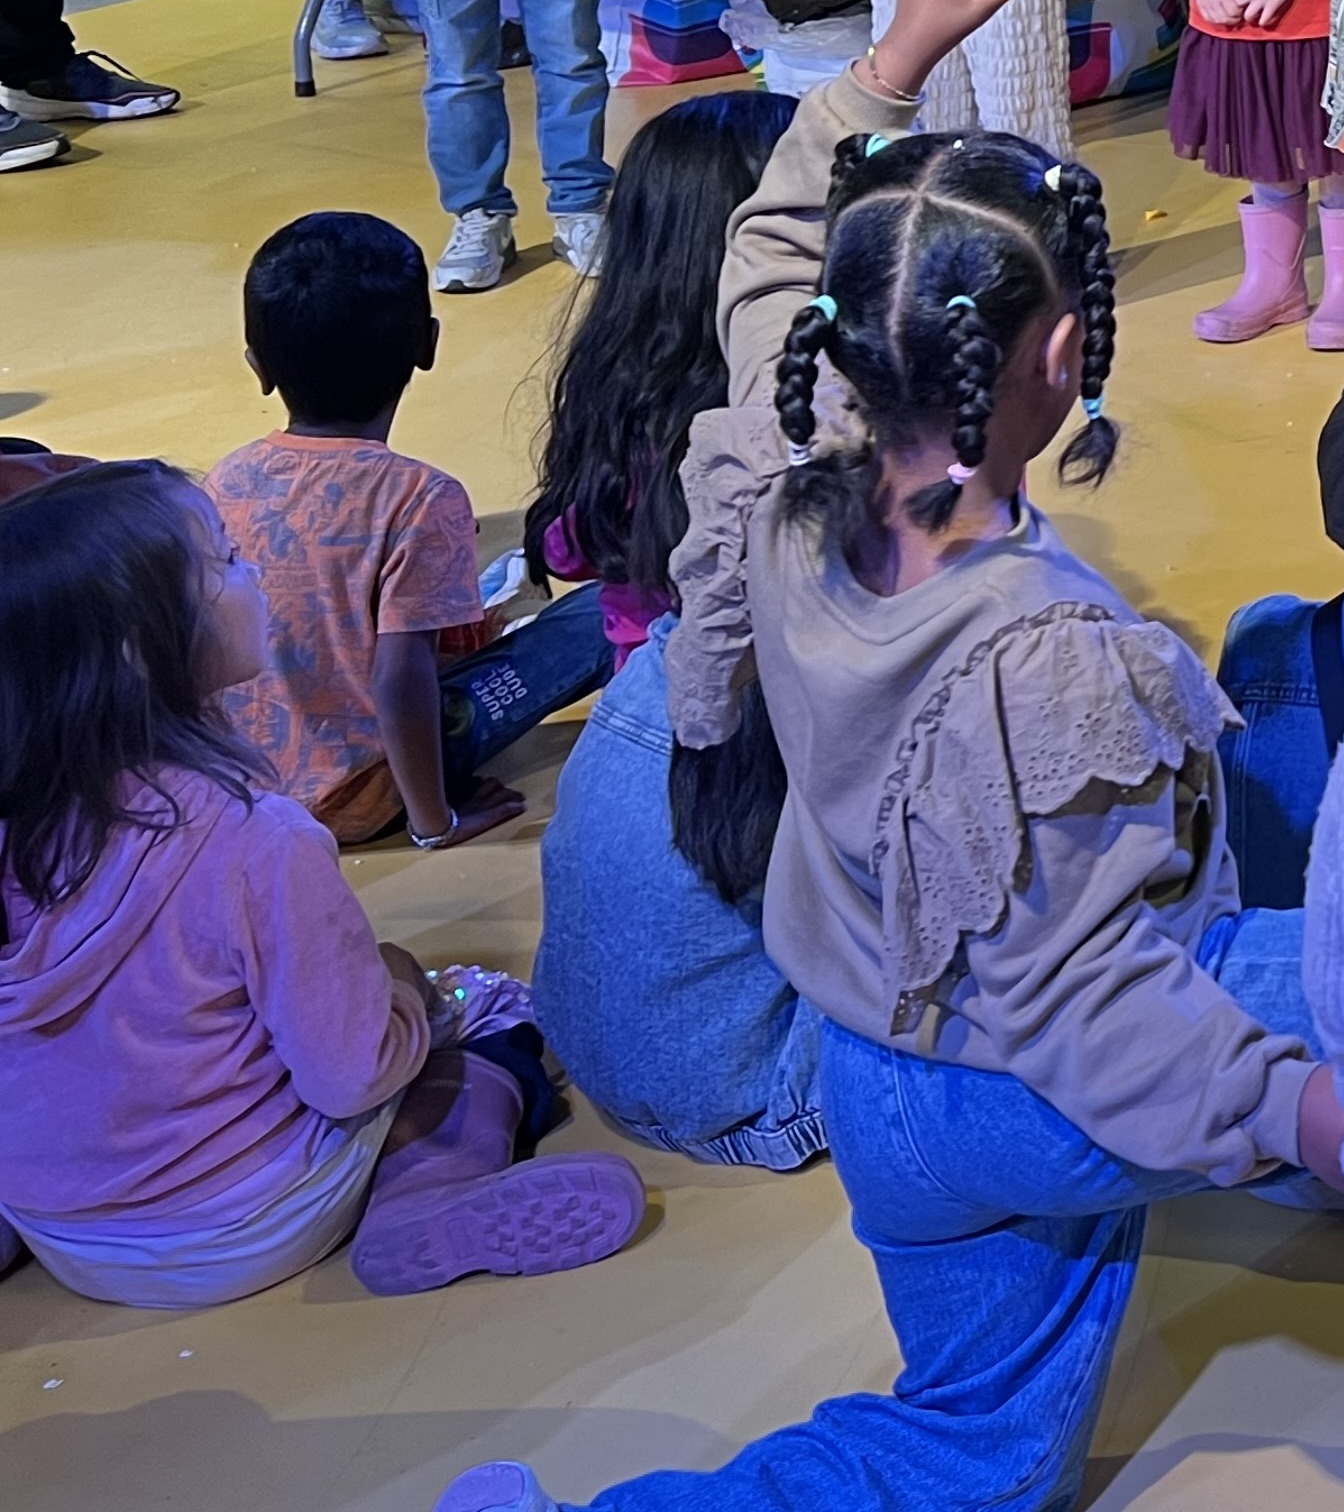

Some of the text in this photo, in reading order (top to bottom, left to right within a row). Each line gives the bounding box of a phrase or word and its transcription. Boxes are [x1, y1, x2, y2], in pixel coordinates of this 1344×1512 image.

[484, 669, 514, 705] COOL
[496, 662, 528, 699] DUDE
[471, 678, 504, 721] SUPER
